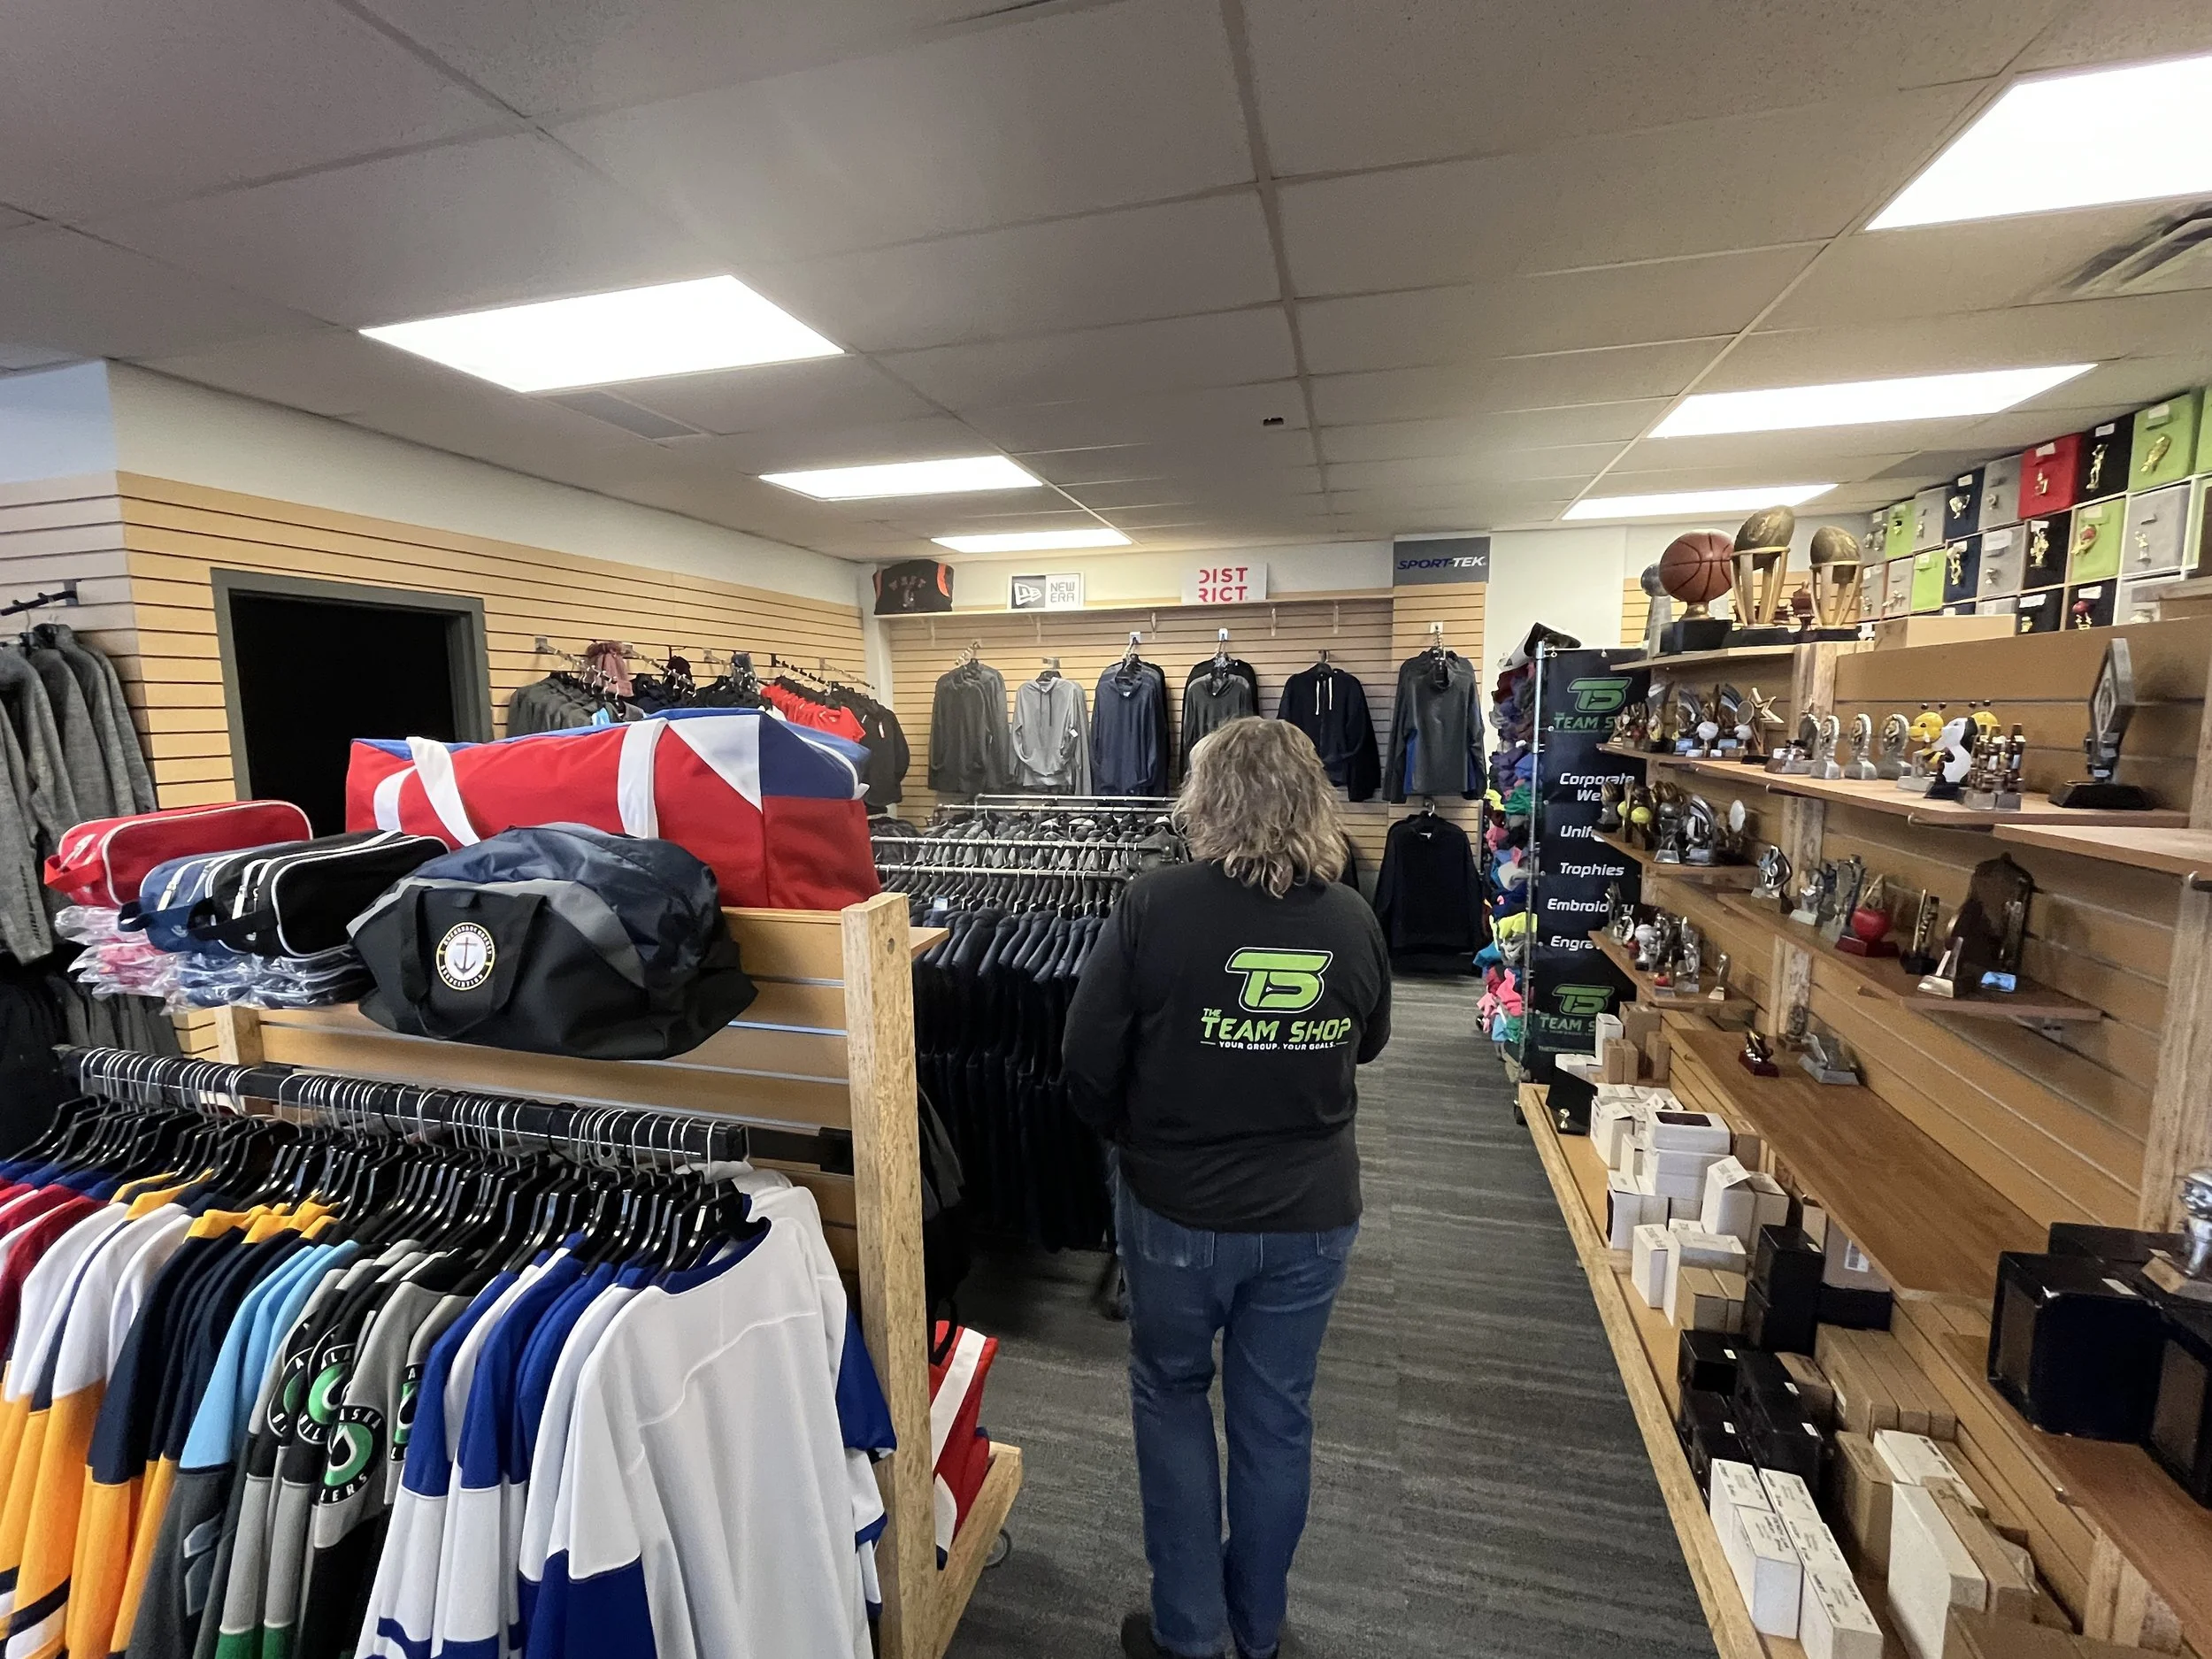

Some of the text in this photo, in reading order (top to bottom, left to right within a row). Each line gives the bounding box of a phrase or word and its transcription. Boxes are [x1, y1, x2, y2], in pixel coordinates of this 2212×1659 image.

[1397, 556, 1486, 570] SPORT-TEK
[1198, 567, 1248, 584] DIST
[1050, 581, 1076, 592] NEW
[1198, 586, 1248, 603] RICT
[1050, 592, 1076, 603] ERA
[1554, 716, 1600, 729] TEAM
[1559, 772, 1635, 788] Corporate
[1577, 789, 1601, 802] We
[1560, 825, 1594, 839] Unif
[1560, 862, 1625, 879] Trophies
[1548, 897, 1635, 916] Embroidy
[1550, 935, 1598, 951] Engra
[1203, 1008, 1223, 1017] THE
[1201, 1017, 1352, 1043] TEAM SHOP
[1540, 1016, 1582, 1032] TEAM
[1219, 1041, 1244, 1049] YOUR
[1246, 1041, 1280, 1050] GROUP.
[1283, 1041, 1307, 1051] YOUR
[319, 1474, 368, 1502] LERS
